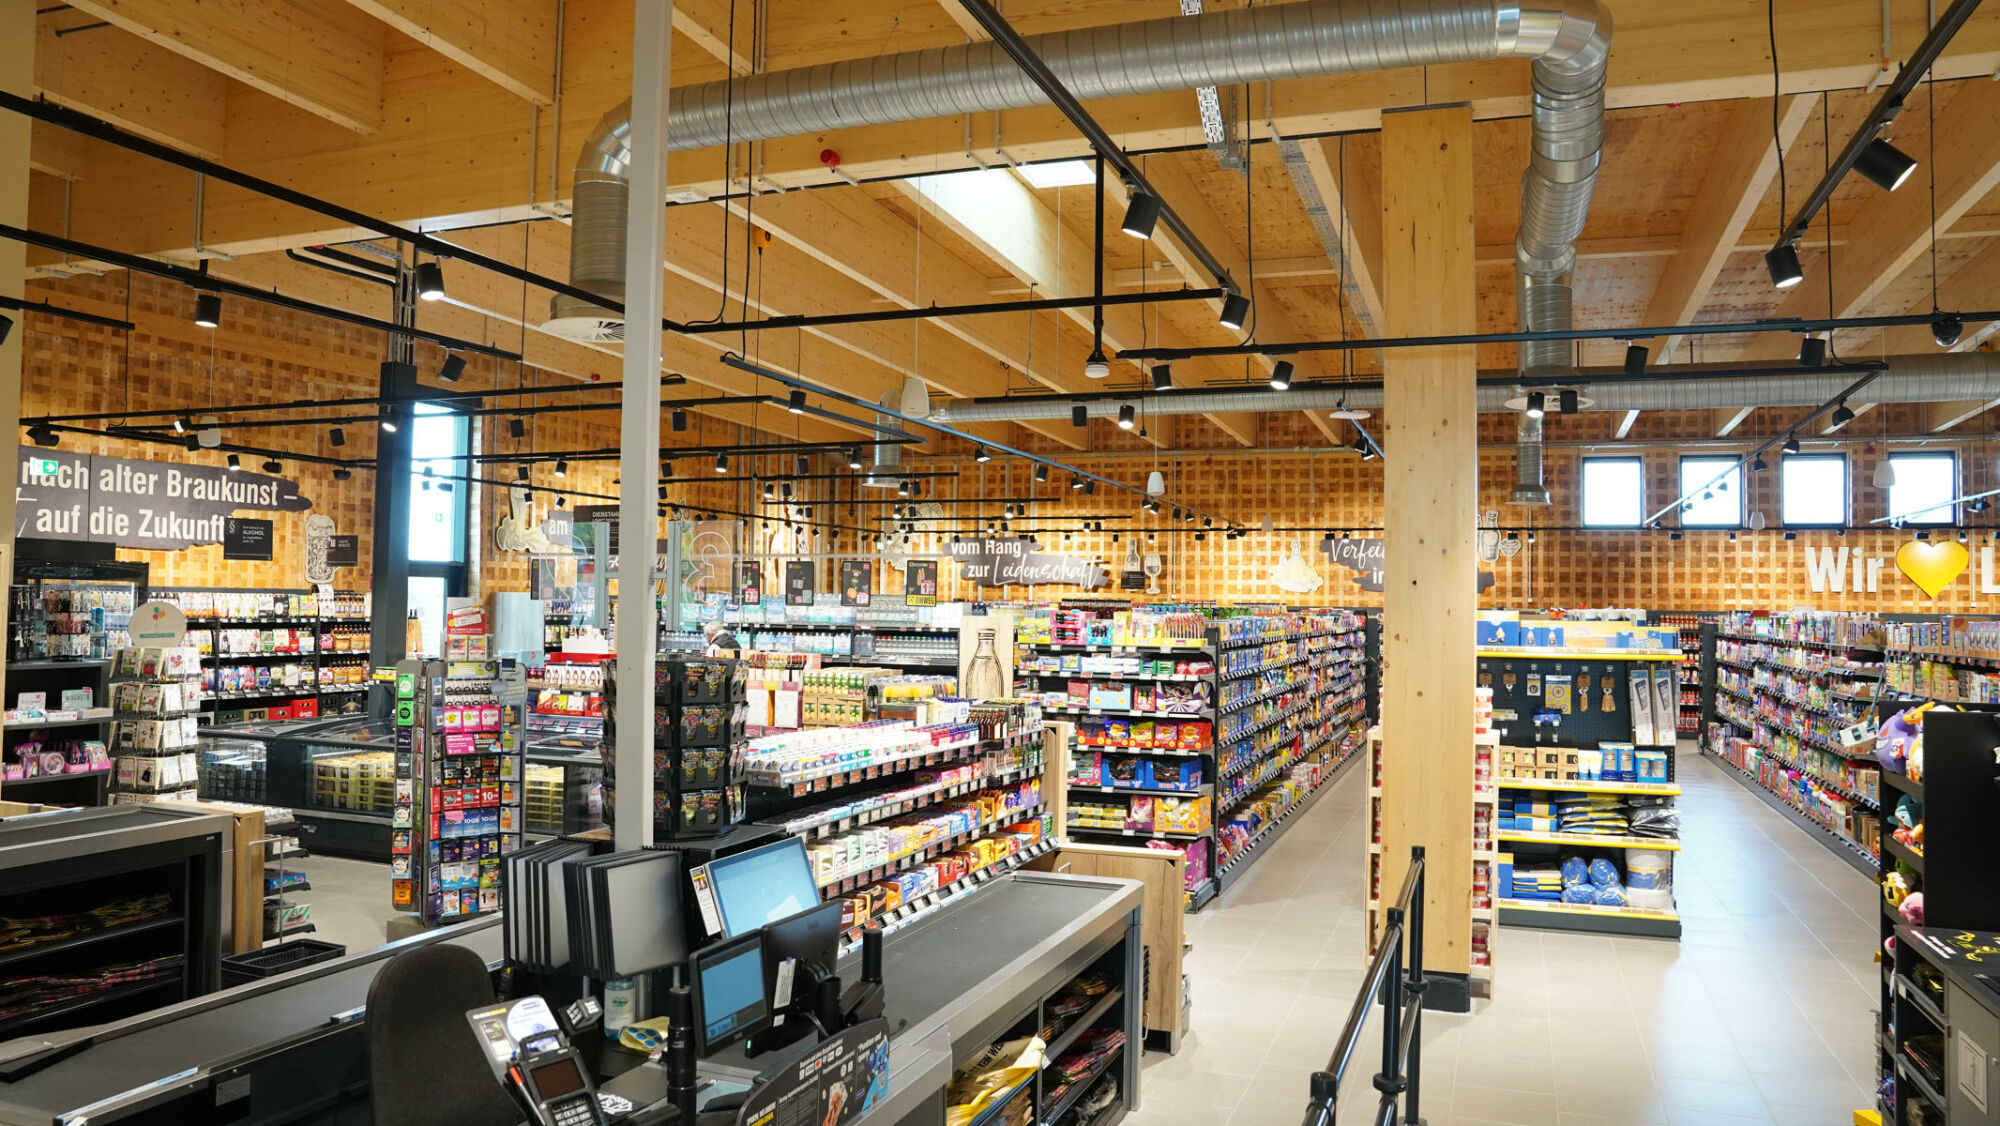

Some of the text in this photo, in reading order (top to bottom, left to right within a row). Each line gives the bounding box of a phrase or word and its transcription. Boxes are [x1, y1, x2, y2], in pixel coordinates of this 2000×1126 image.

[99, 463, 159, 496] alter
[167, 470, 278, 507] Braukunst
[36, 505, 81, 534] auf
[89, 505, 130, 537] die
[549, 520, 568, 535] am
[950, 539, 1022, 558] vom Hang
[1331, 539, 1385, 569] Verfei
[967, 555, 1105, 591] zur Leidenschaft
[1804, 545, 1885, 594] Wir
